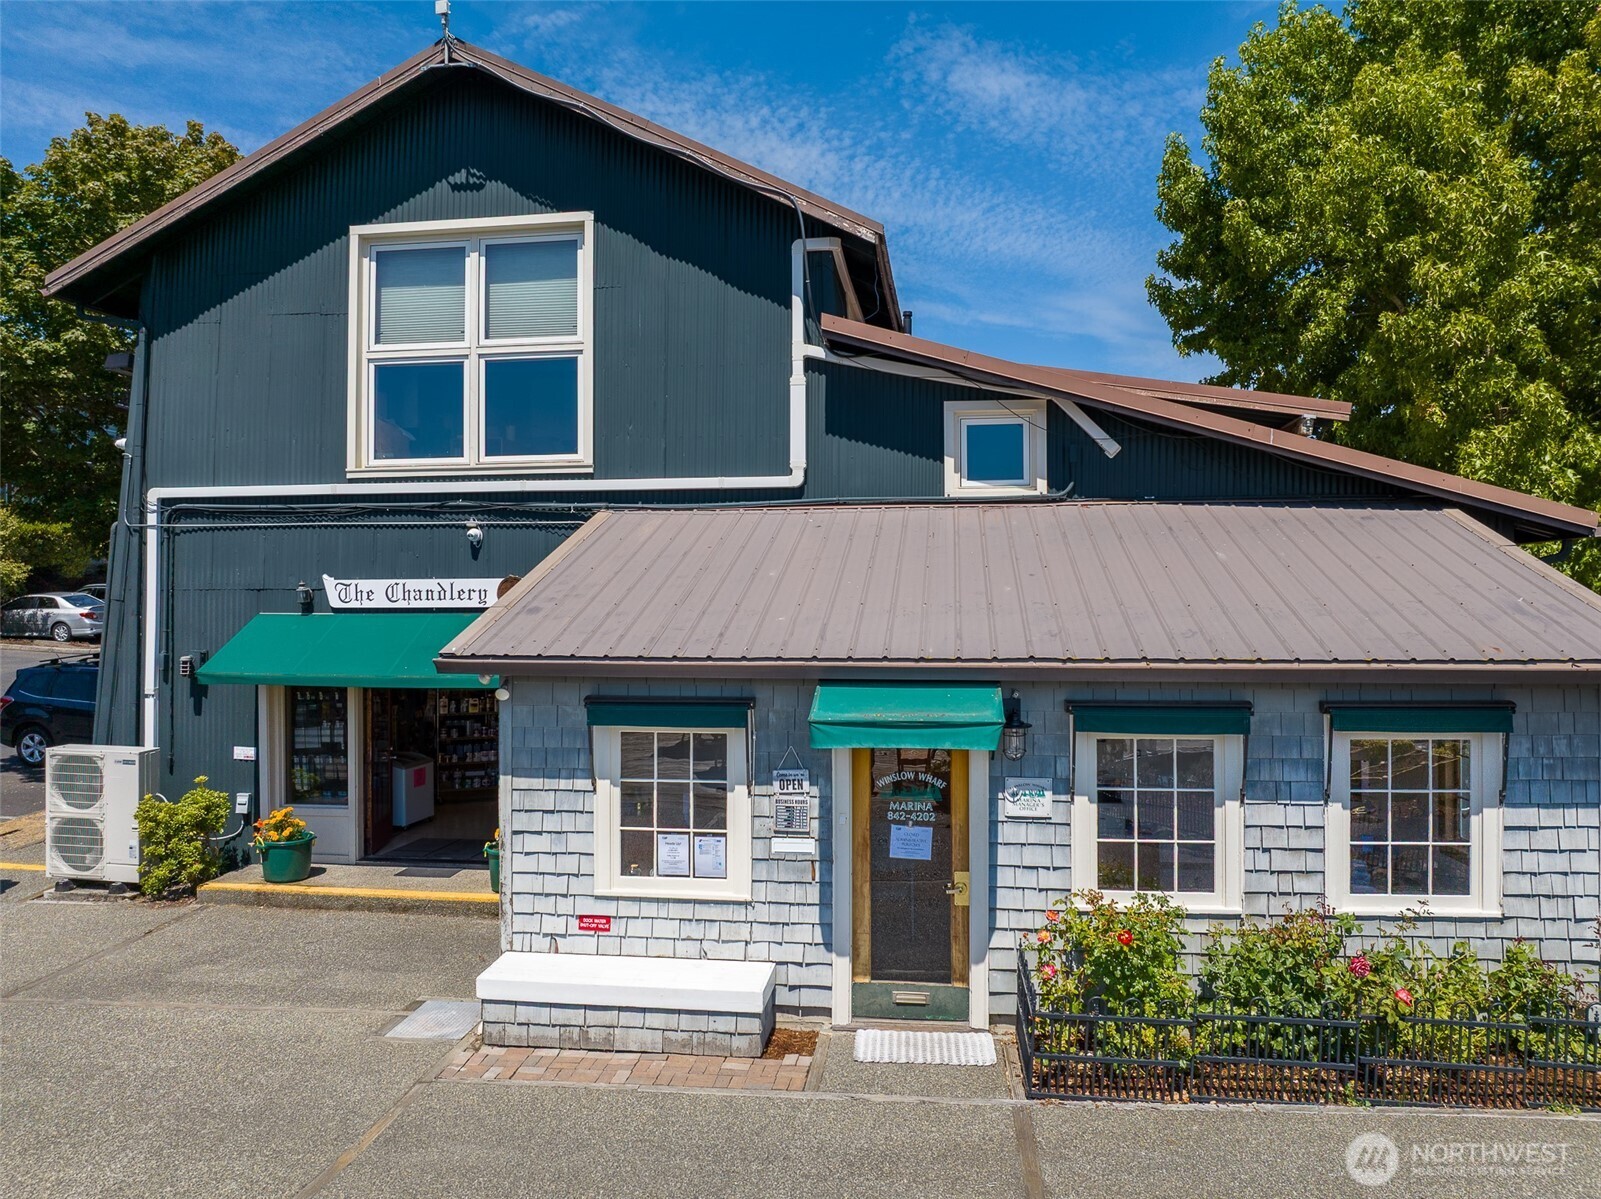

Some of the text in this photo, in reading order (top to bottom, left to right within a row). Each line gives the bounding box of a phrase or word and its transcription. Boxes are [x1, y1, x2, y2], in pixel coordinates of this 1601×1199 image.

[334, 581, 488, 606] The Chandlery
[779, 778, 804, 791] OPEN
[876, 771, 948, 790] WINSLOW WHARF
[889, 801, 933, 811] MARINA
[887, 811, 936, 822] 842-4202
